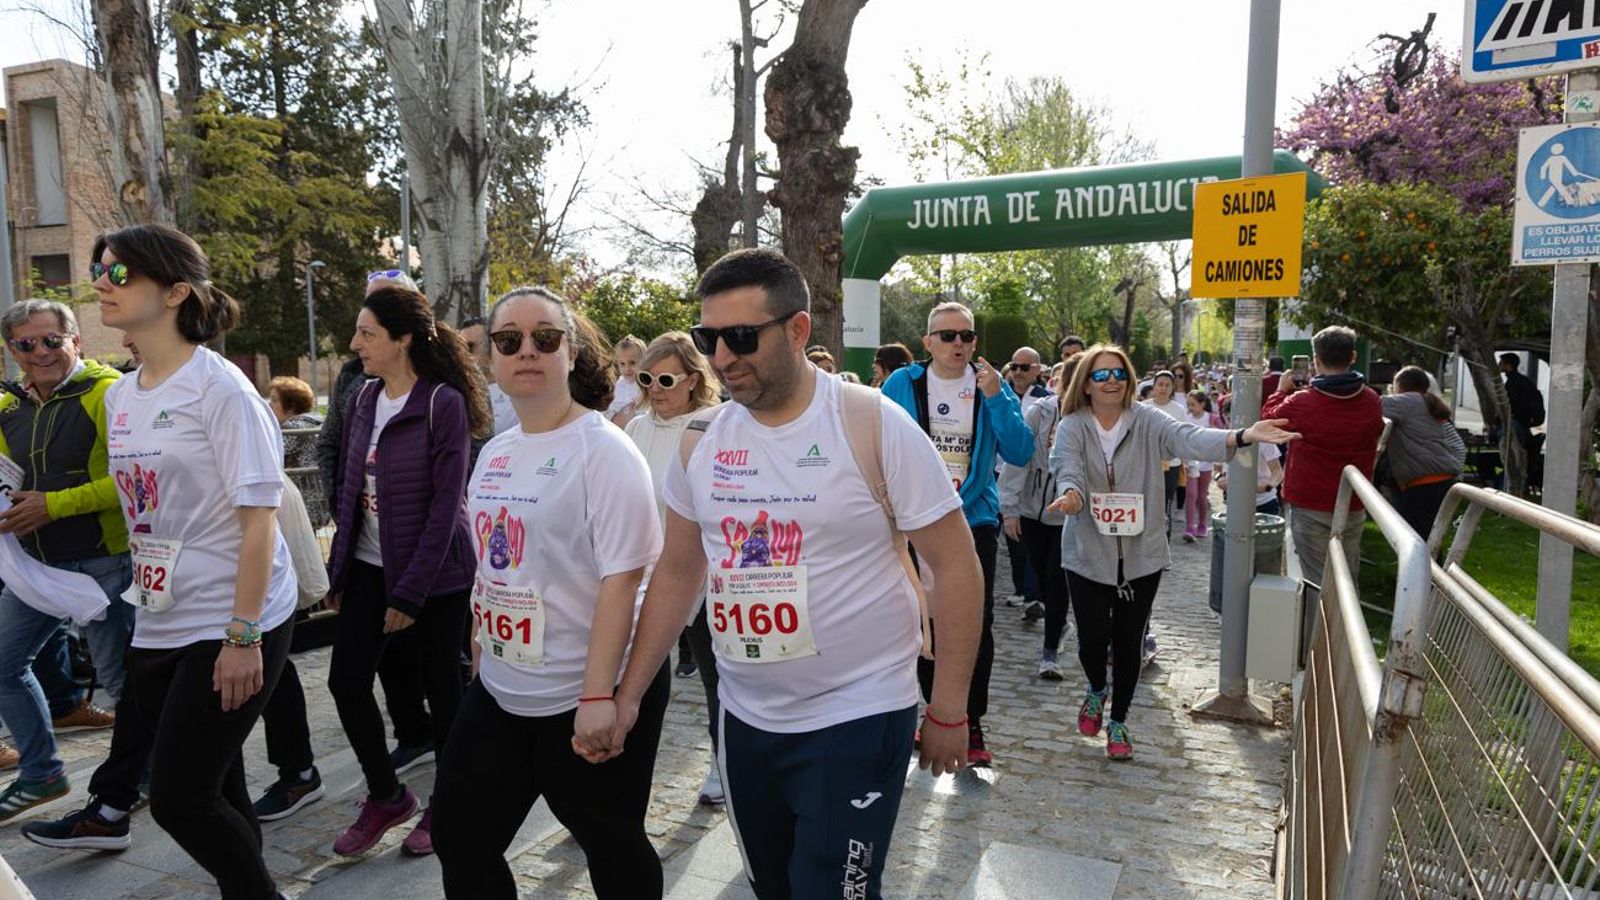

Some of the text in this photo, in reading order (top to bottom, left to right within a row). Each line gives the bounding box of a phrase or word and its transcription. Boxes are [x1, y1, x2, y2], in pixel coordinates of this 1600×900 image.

[907, 195, 991, 229] JUNTA
[1006, 191, 1040, 223] DE
[1222, 190, 1276, 215] SALIDA
[1238, 224, 1257, 246] DE
[1528, 227, 1543, 236] ES
[1540, 235, 1584, 246] LLEVAR
[1524, 247, 1571, 257] PERROS
[1205, 258, 1284, 282] CAMIONES
[714, 448, 749, 466] XXVII
[1092, 507, 1136, 523] 5021
[713, 602, 799, 635] 5160
